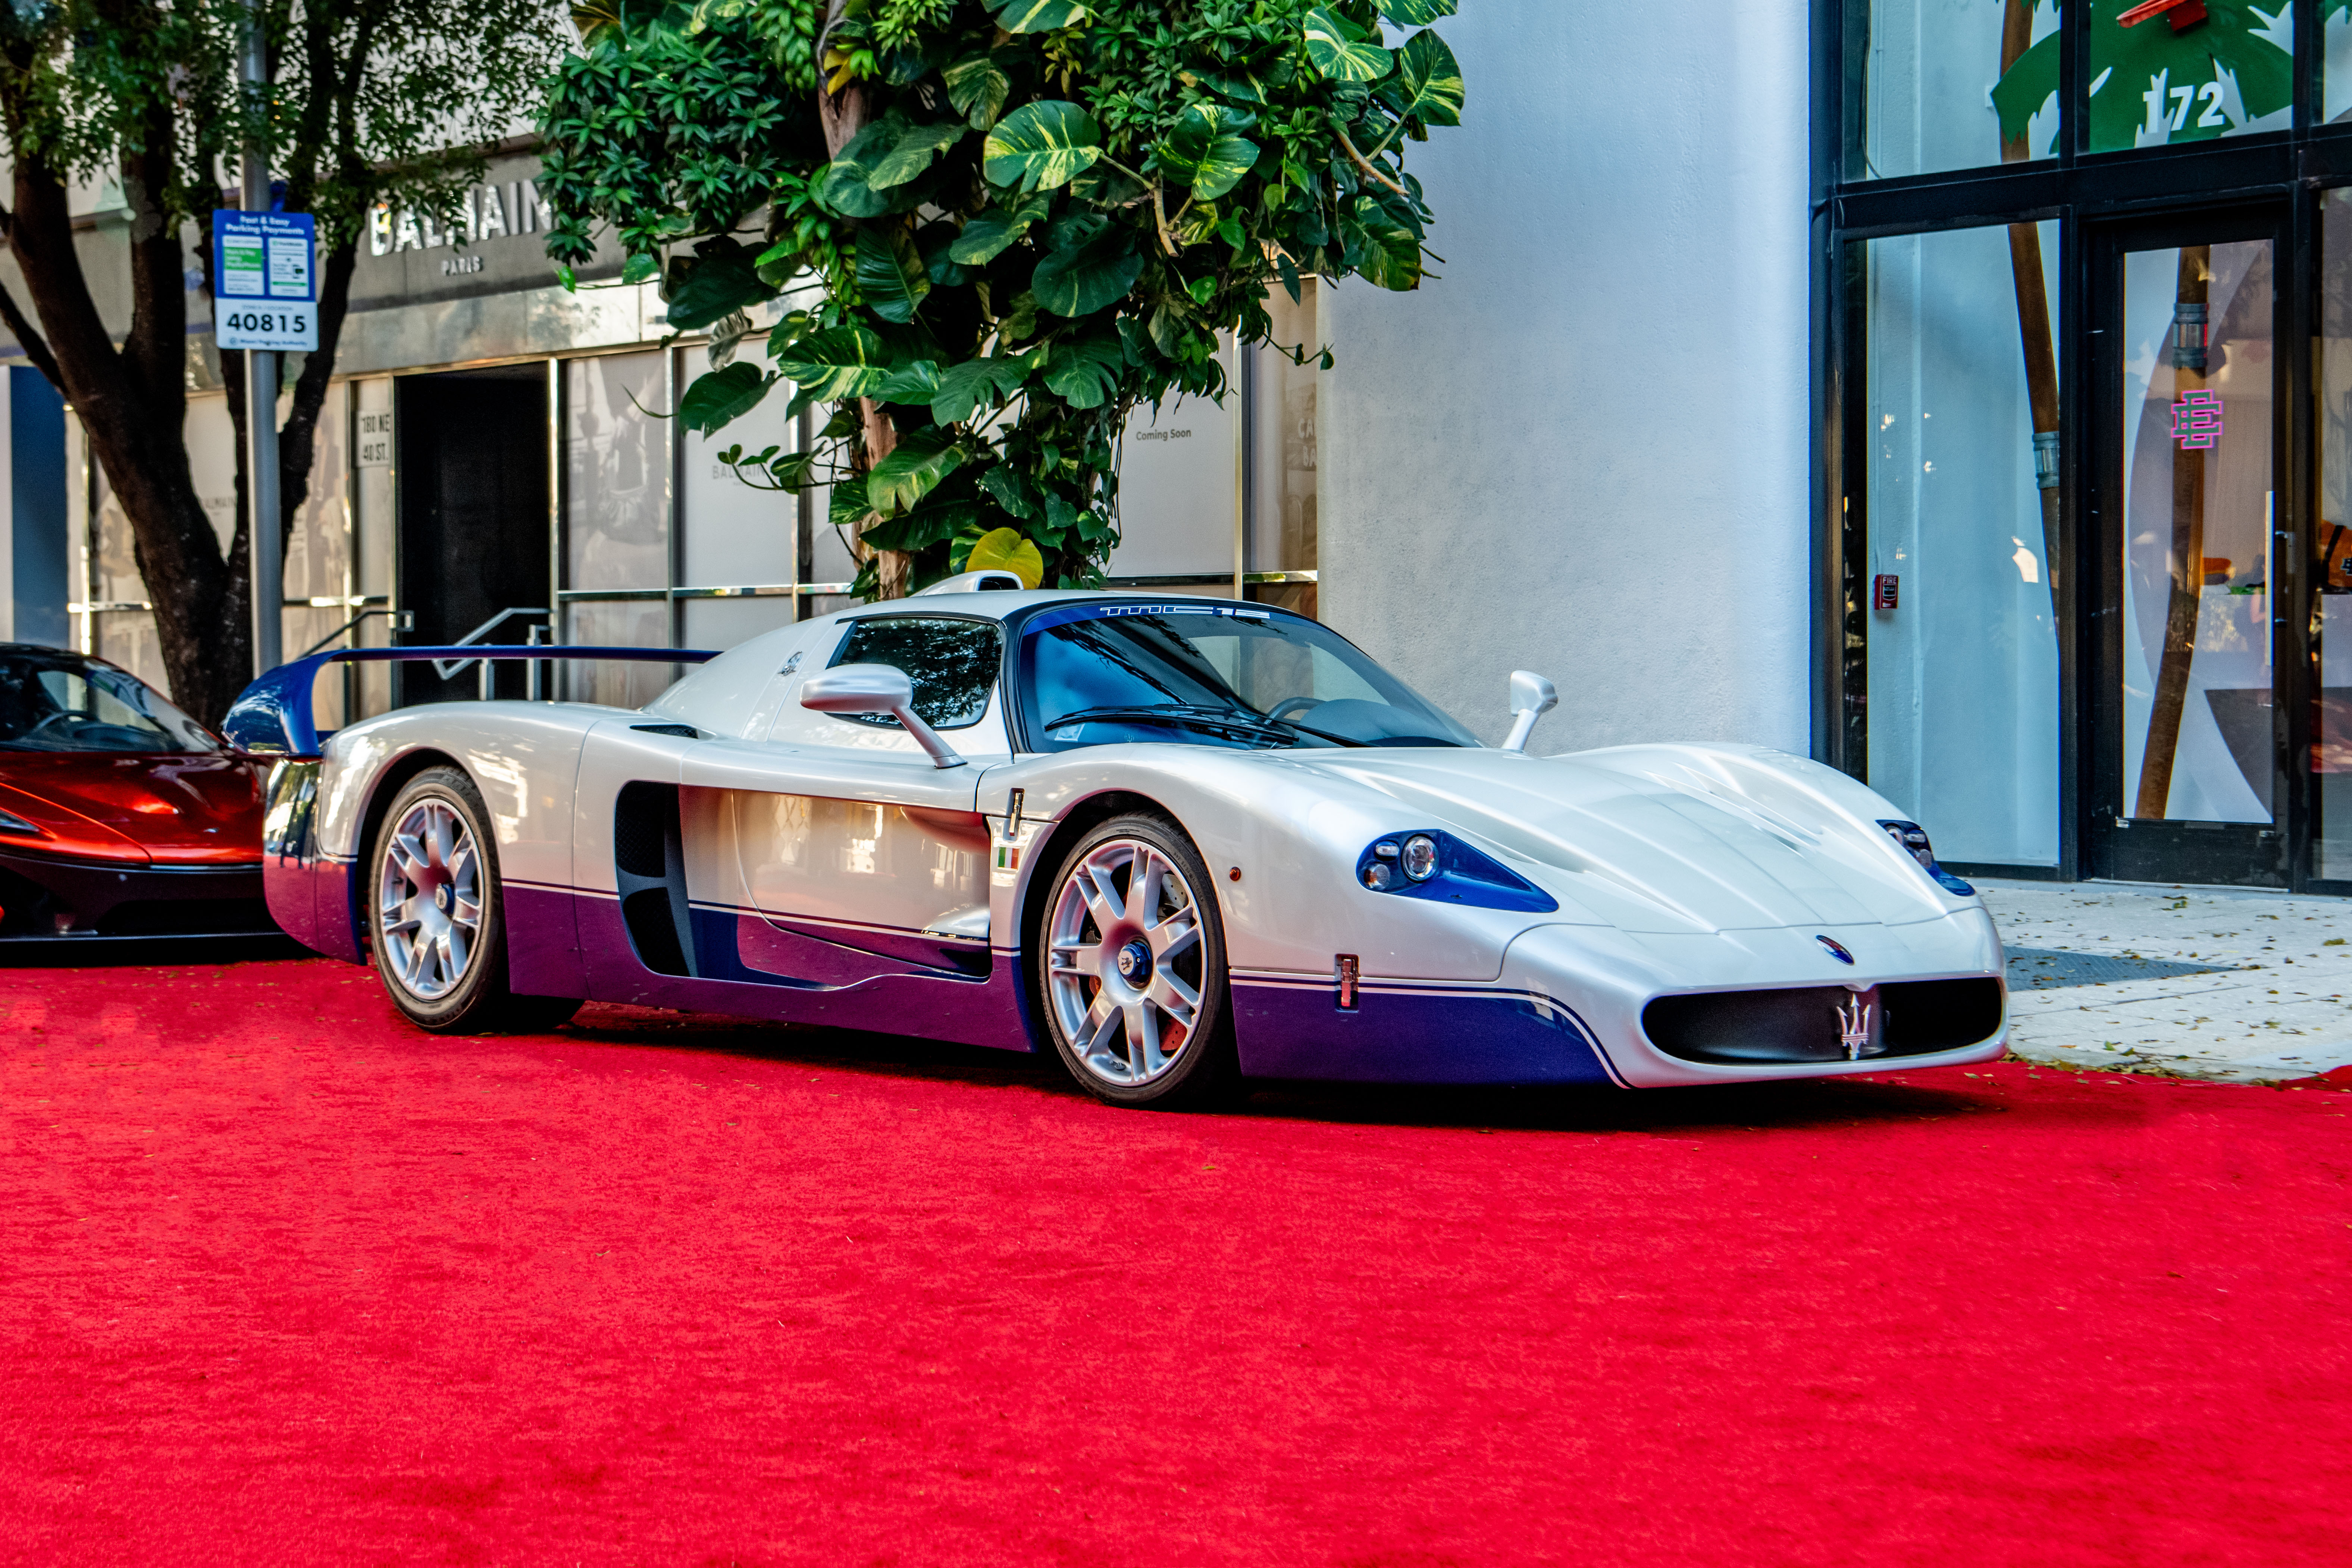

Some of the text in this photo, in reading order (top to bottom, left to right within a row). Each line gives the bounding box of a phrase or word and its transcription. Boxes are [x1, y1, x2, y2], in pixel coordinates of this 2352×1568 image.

[2143, 81, 2225, 134] 172
[225, 223, 305, 235] Parking Payments
[240, 216, 259, 224] Fast
[269, 217, 290, 227] Easy
[441, 256, 481, 276] PARIS
[227, 313, 307, 332] 40815
[1136, 429, 1191, 441] Coming Soon
[1298, 417, 1317, 439] CA
